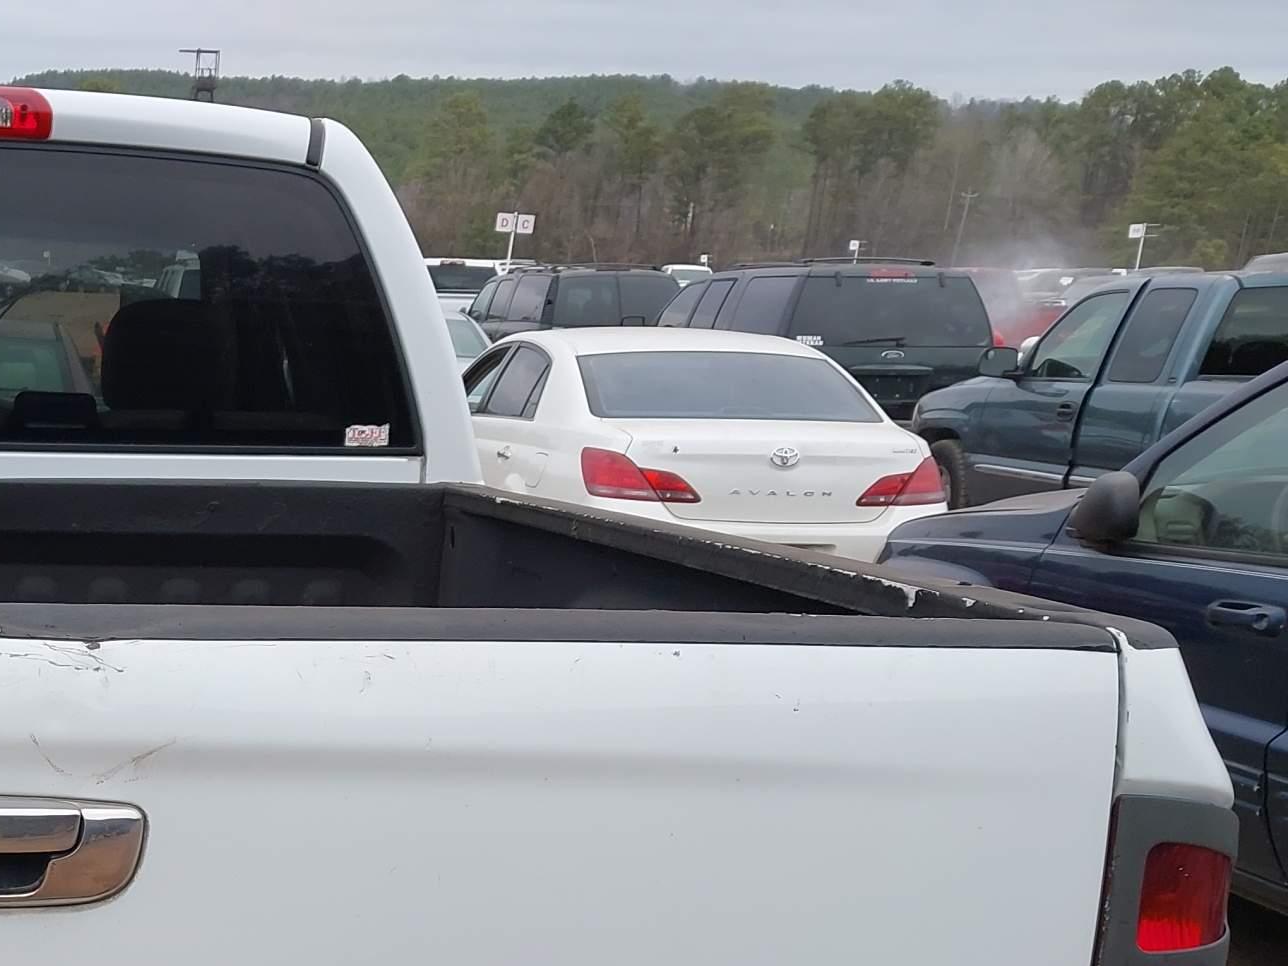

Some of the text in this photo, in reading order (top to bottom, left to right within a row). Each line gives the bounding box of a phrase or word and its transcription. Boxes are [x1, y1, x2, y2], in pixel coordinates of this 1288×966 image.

[501, 217, 509, 228] D
[522, 219, 530, 229] C
[728, 489, 833, 497] AVALON
